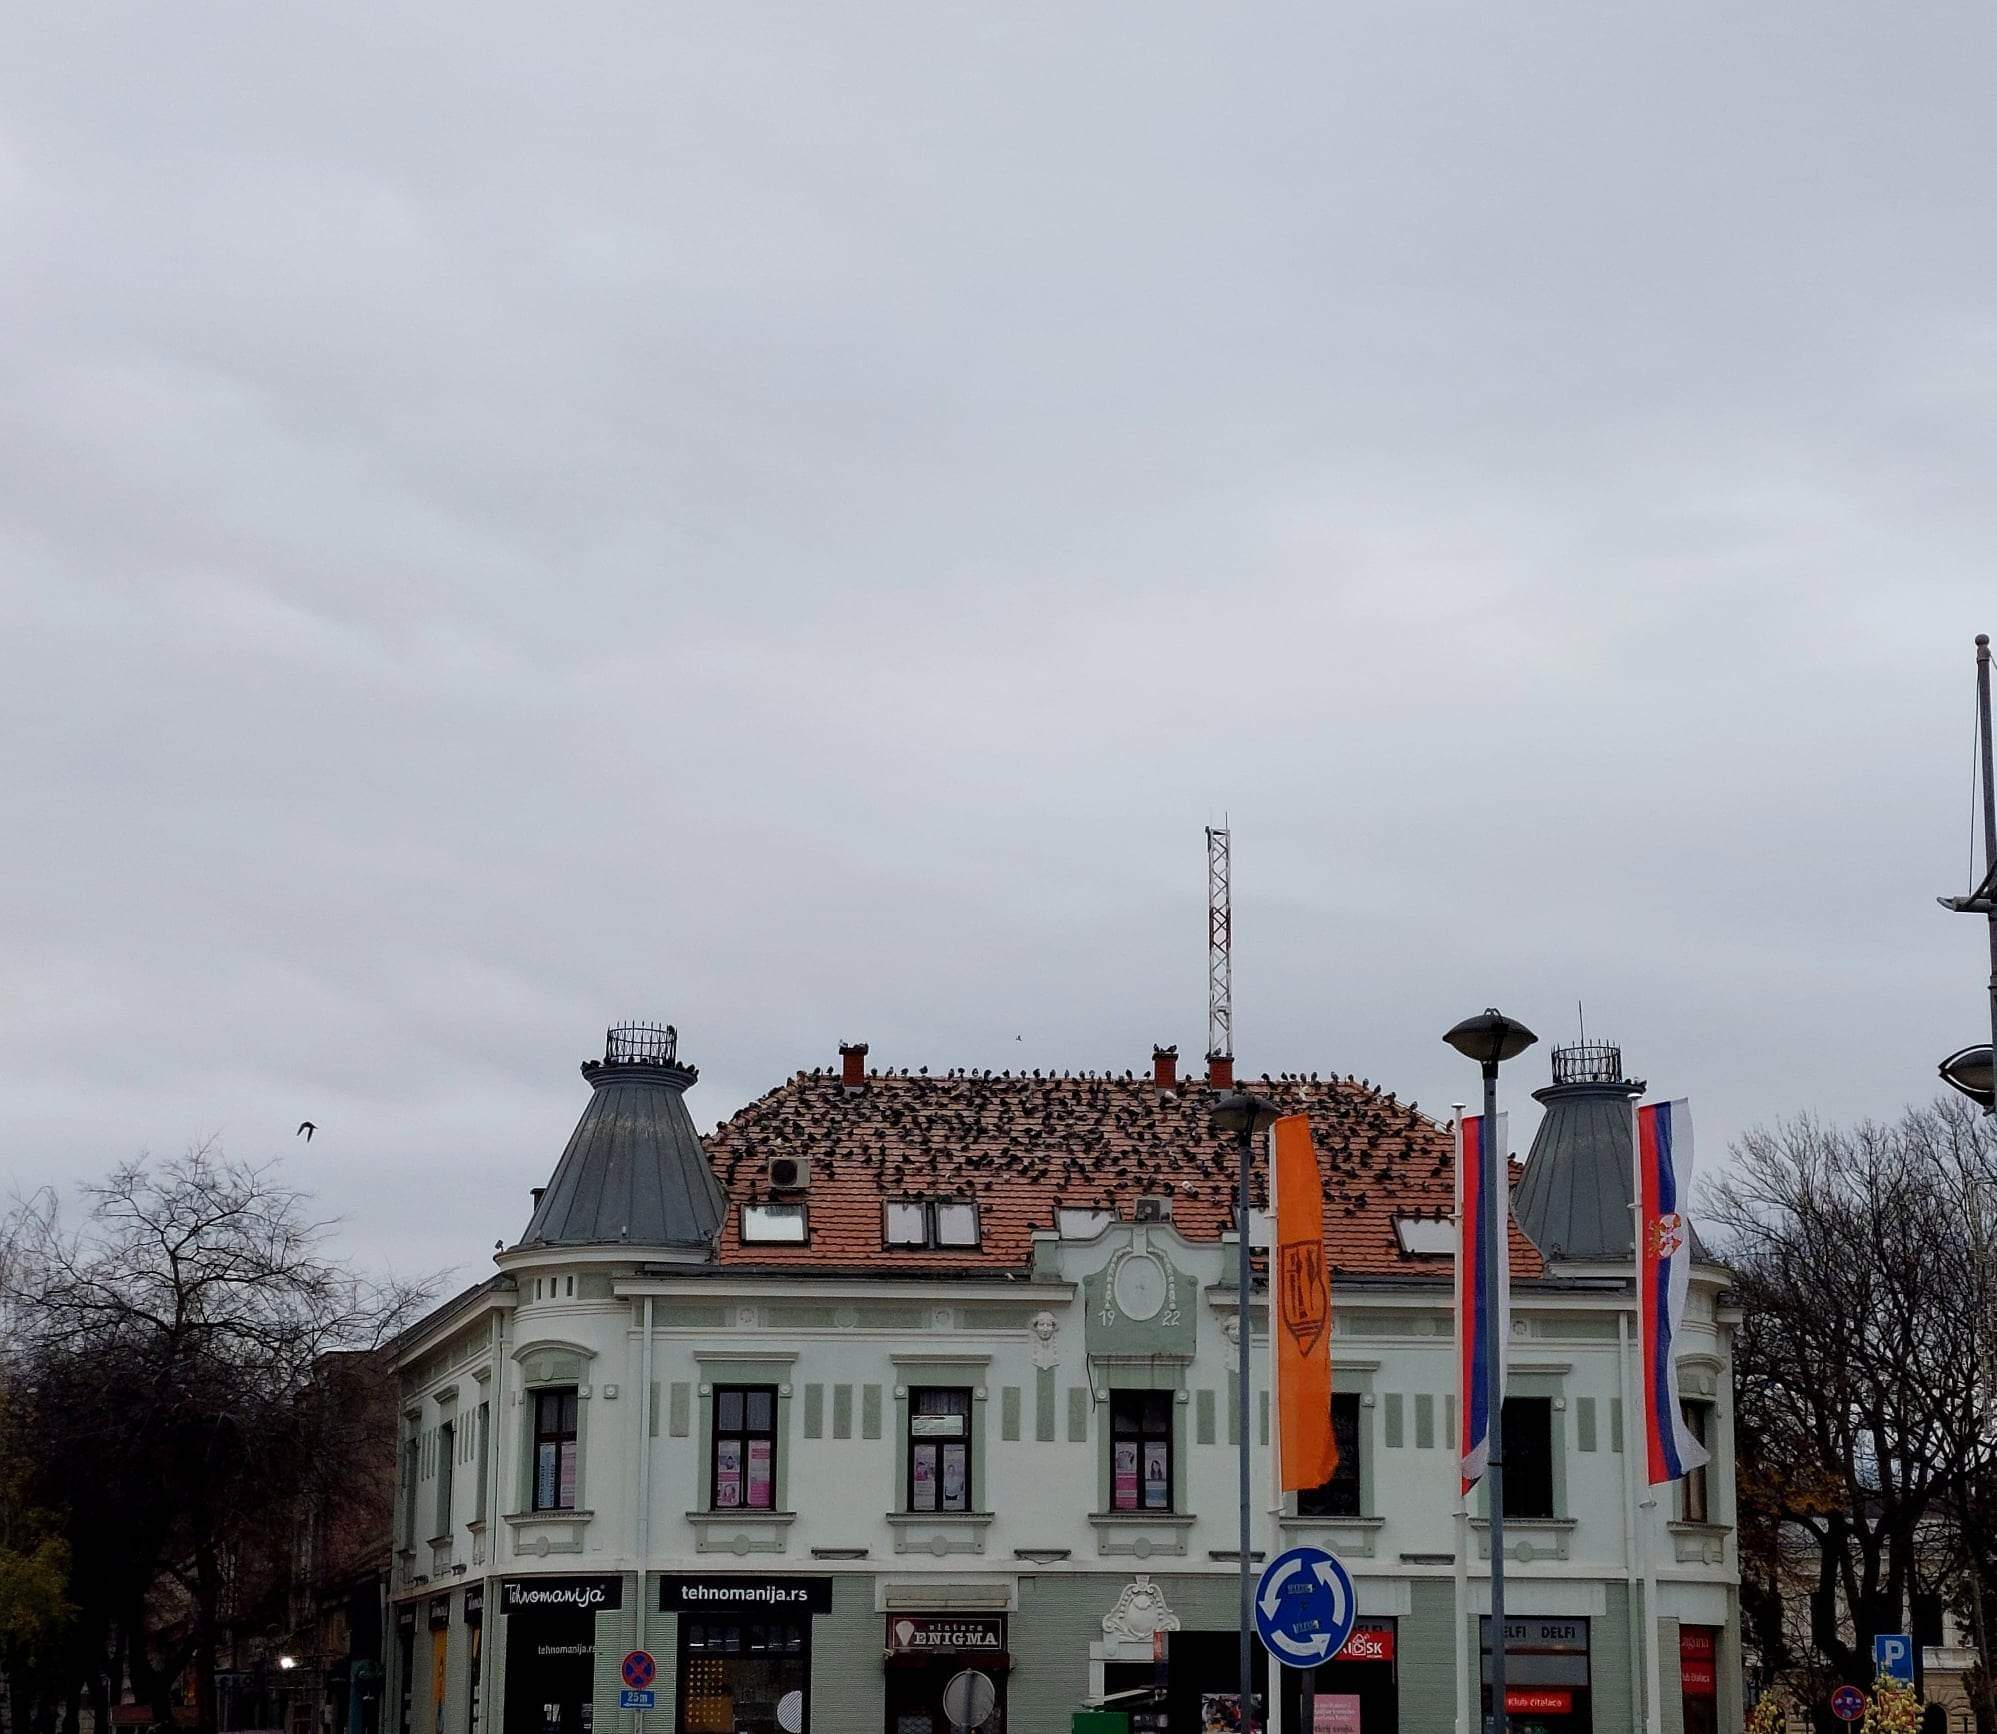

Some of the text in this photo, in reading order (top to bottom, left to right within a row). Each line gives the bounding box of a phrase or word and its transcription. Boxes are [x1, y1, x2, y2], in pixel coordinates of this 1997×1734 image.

[505, 1584, 605, 1607] Tehnomanija
[681, 1585, 808, 1603] tehnomanija.rs
[914, 1632, 998, 1645] ENIGMA
[1503, 1626, 1576, 1639] ELFI DELFI
[1885, 1640, 1905, 1667] P
